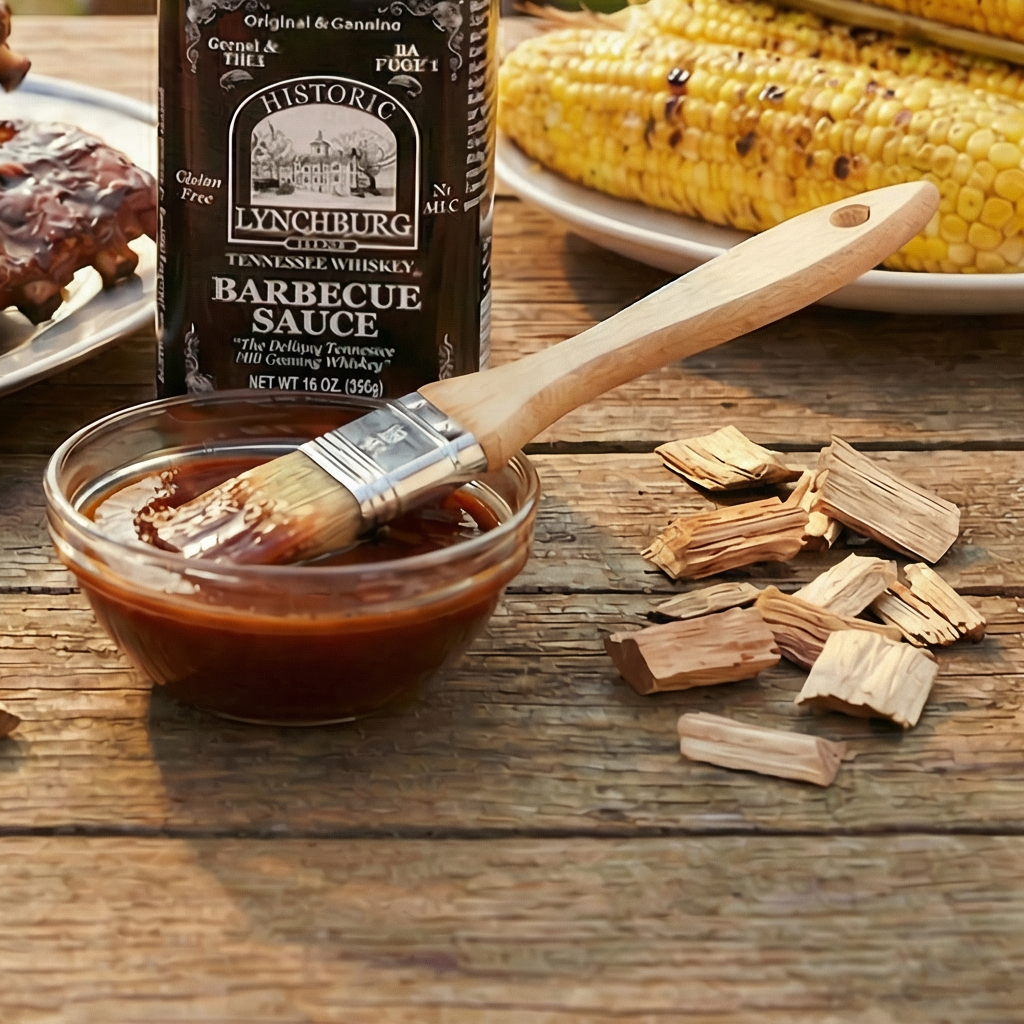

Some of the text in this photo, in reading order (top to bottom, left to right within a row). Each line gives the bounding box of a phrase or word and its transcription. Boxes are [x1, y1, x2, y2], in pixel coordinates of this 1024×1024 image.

[314, 16, 329, 30] &
[261, 83, 396, 120] HISTORIC
[235, 206, 412, 237] LYNCHBURG
[227, 254, 414, 273] TENNESSEE WHISKEY
[211, 276, 422, 310] BARBECUE
[252, 307, 379, 338] SAUCE
[249, 374, 275, 389] NET
[278, 376, 299, 390] WT
[302, 377, 317, 392] 16
